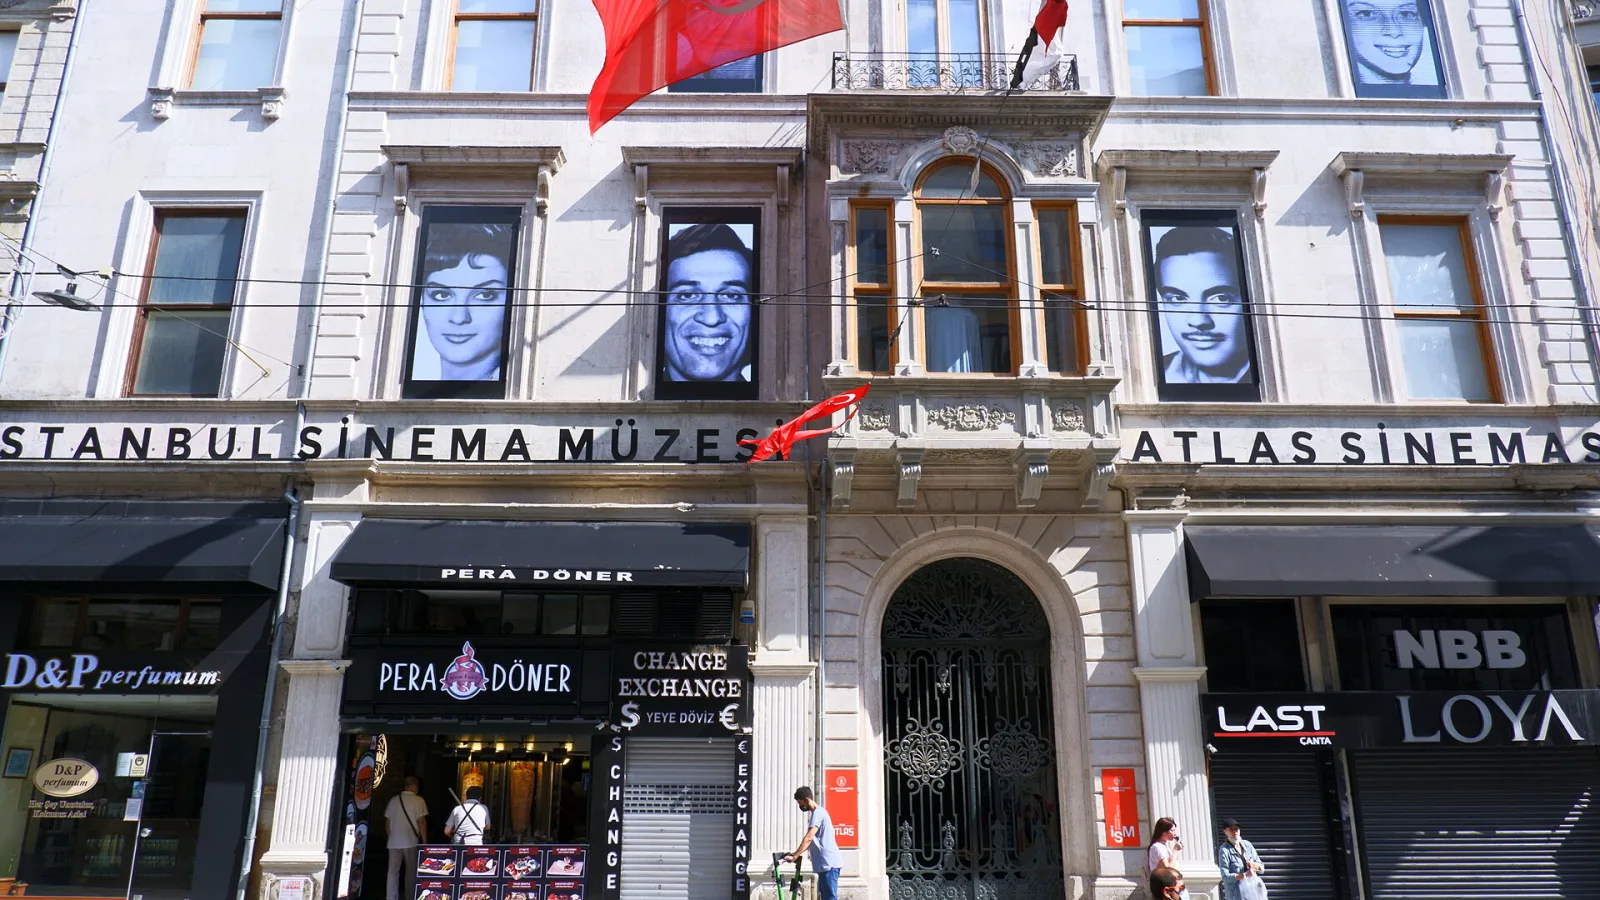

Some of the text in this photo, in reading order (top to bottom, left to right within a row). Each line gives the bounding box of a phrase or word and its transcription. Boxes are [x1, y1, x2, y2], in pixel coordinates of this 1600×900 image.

[0, 426, 272, 459] STANBUL
[300, 417, 531, 461] SİNEMA
[1132, 430, 1317, 464] ATLAS
[441, 569, 633, 581] PERA DÖNER
[633, 652, 727, 670] CHANGE
[1393, 630, 1526, 669] NBB
[1, 653, 222, 689] D&P perfumum
[380, 659, 572, 693] PERA DÖNER
[618, 678, 742, 698] EXCHANGE
[646, 712, 676, 723] YEYE
[680, 709, 714, 723] DÖVİZ
[1218, 706, 1326, 731] LAST
[606, 765, 621, 889] CHANGE
[735, 764, 748, 891] EXCHANGE
[834, 827, 854, 836] TLAS
